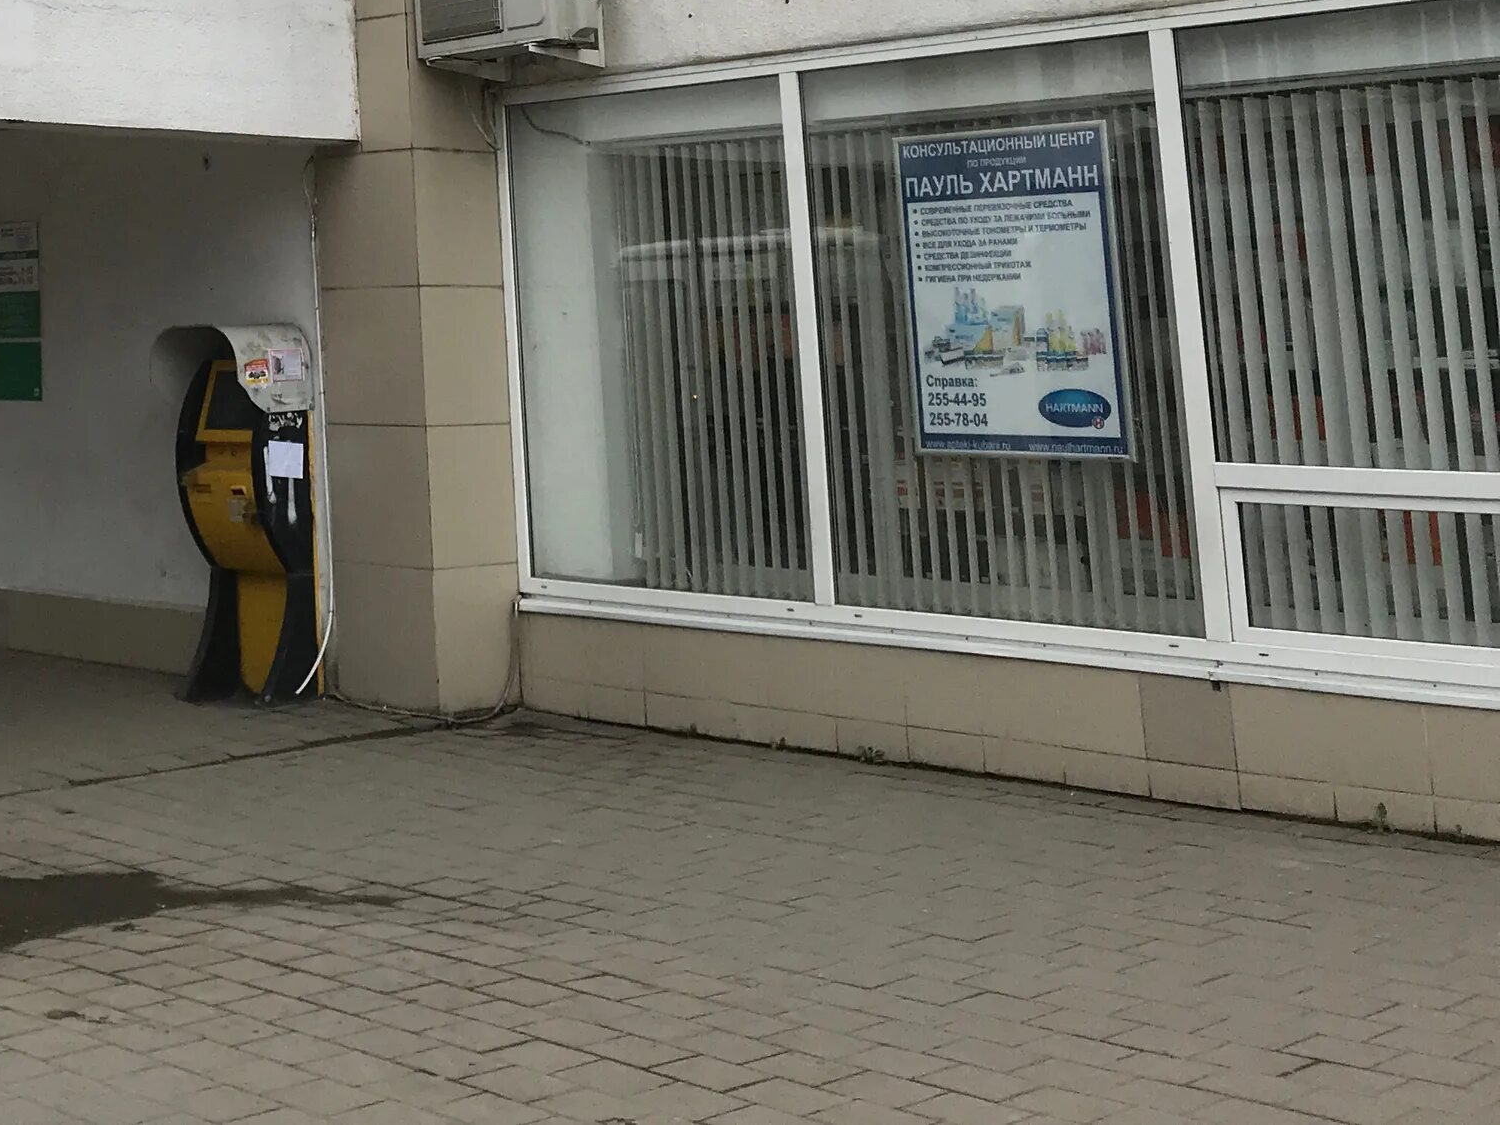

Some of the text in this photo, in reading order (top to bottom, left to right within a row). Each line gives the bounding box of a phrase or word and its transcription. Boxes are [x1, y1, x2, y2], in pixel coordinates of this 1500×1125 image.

[902, 130, 1095, 159] КОНСУЛЬТАЦИОННЫЙ ЦЕНТР
[904, 164, 1099, 198] ПАУЛЬ ХАРТМАНН
[1033, 198, 1074, 209] СРЕДСТВА
[925, 374, 979, 390] Справка:
[927, 391, 987, 407] 255-44-95
[1045, 402, 1104, 414] HARTMANN
[929, 412, 989, 427] 255-78-04
